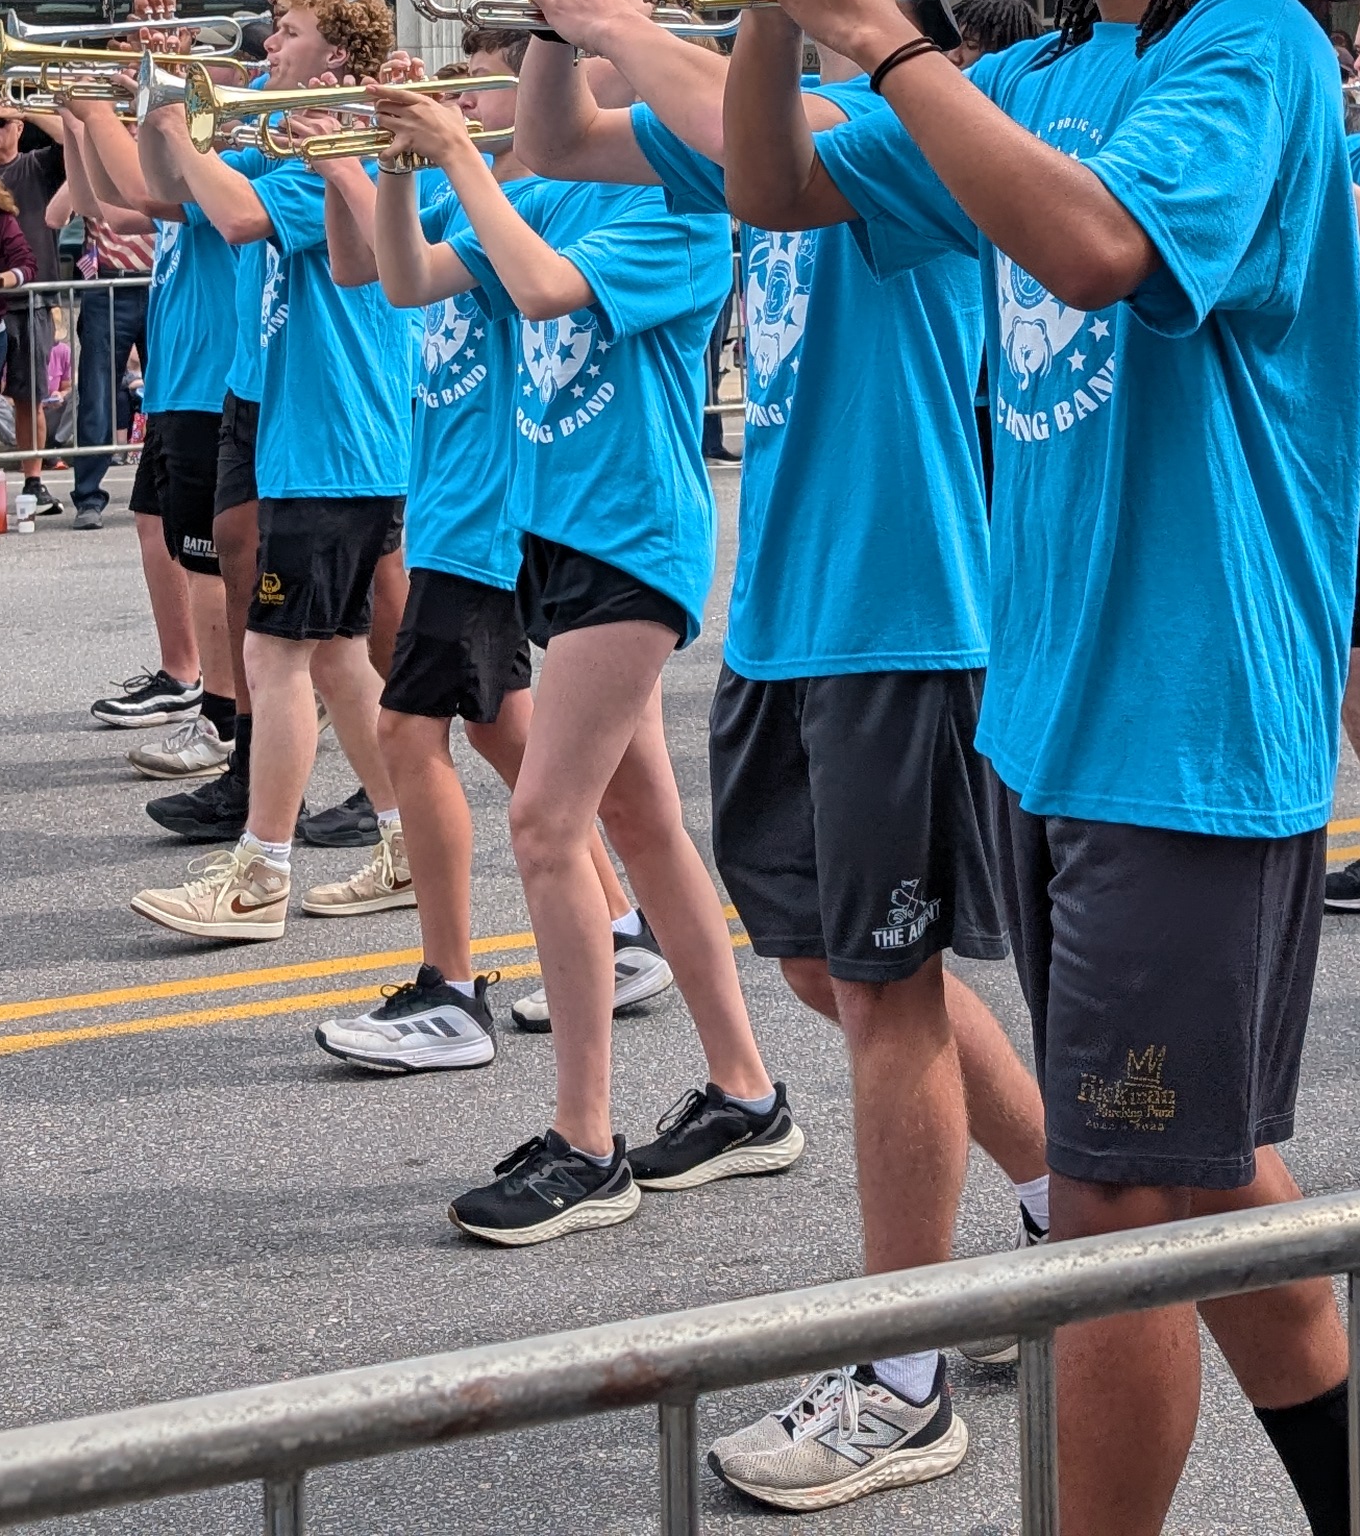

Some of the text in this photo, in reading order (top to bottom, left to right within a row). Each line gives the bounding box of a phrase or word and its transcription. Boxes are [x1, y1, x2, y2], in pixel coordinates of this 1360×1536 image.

[441, 364, 488, 406] BAND
[559, 381, 616, 438] BAND
[872, 928, 904, 948] THE
